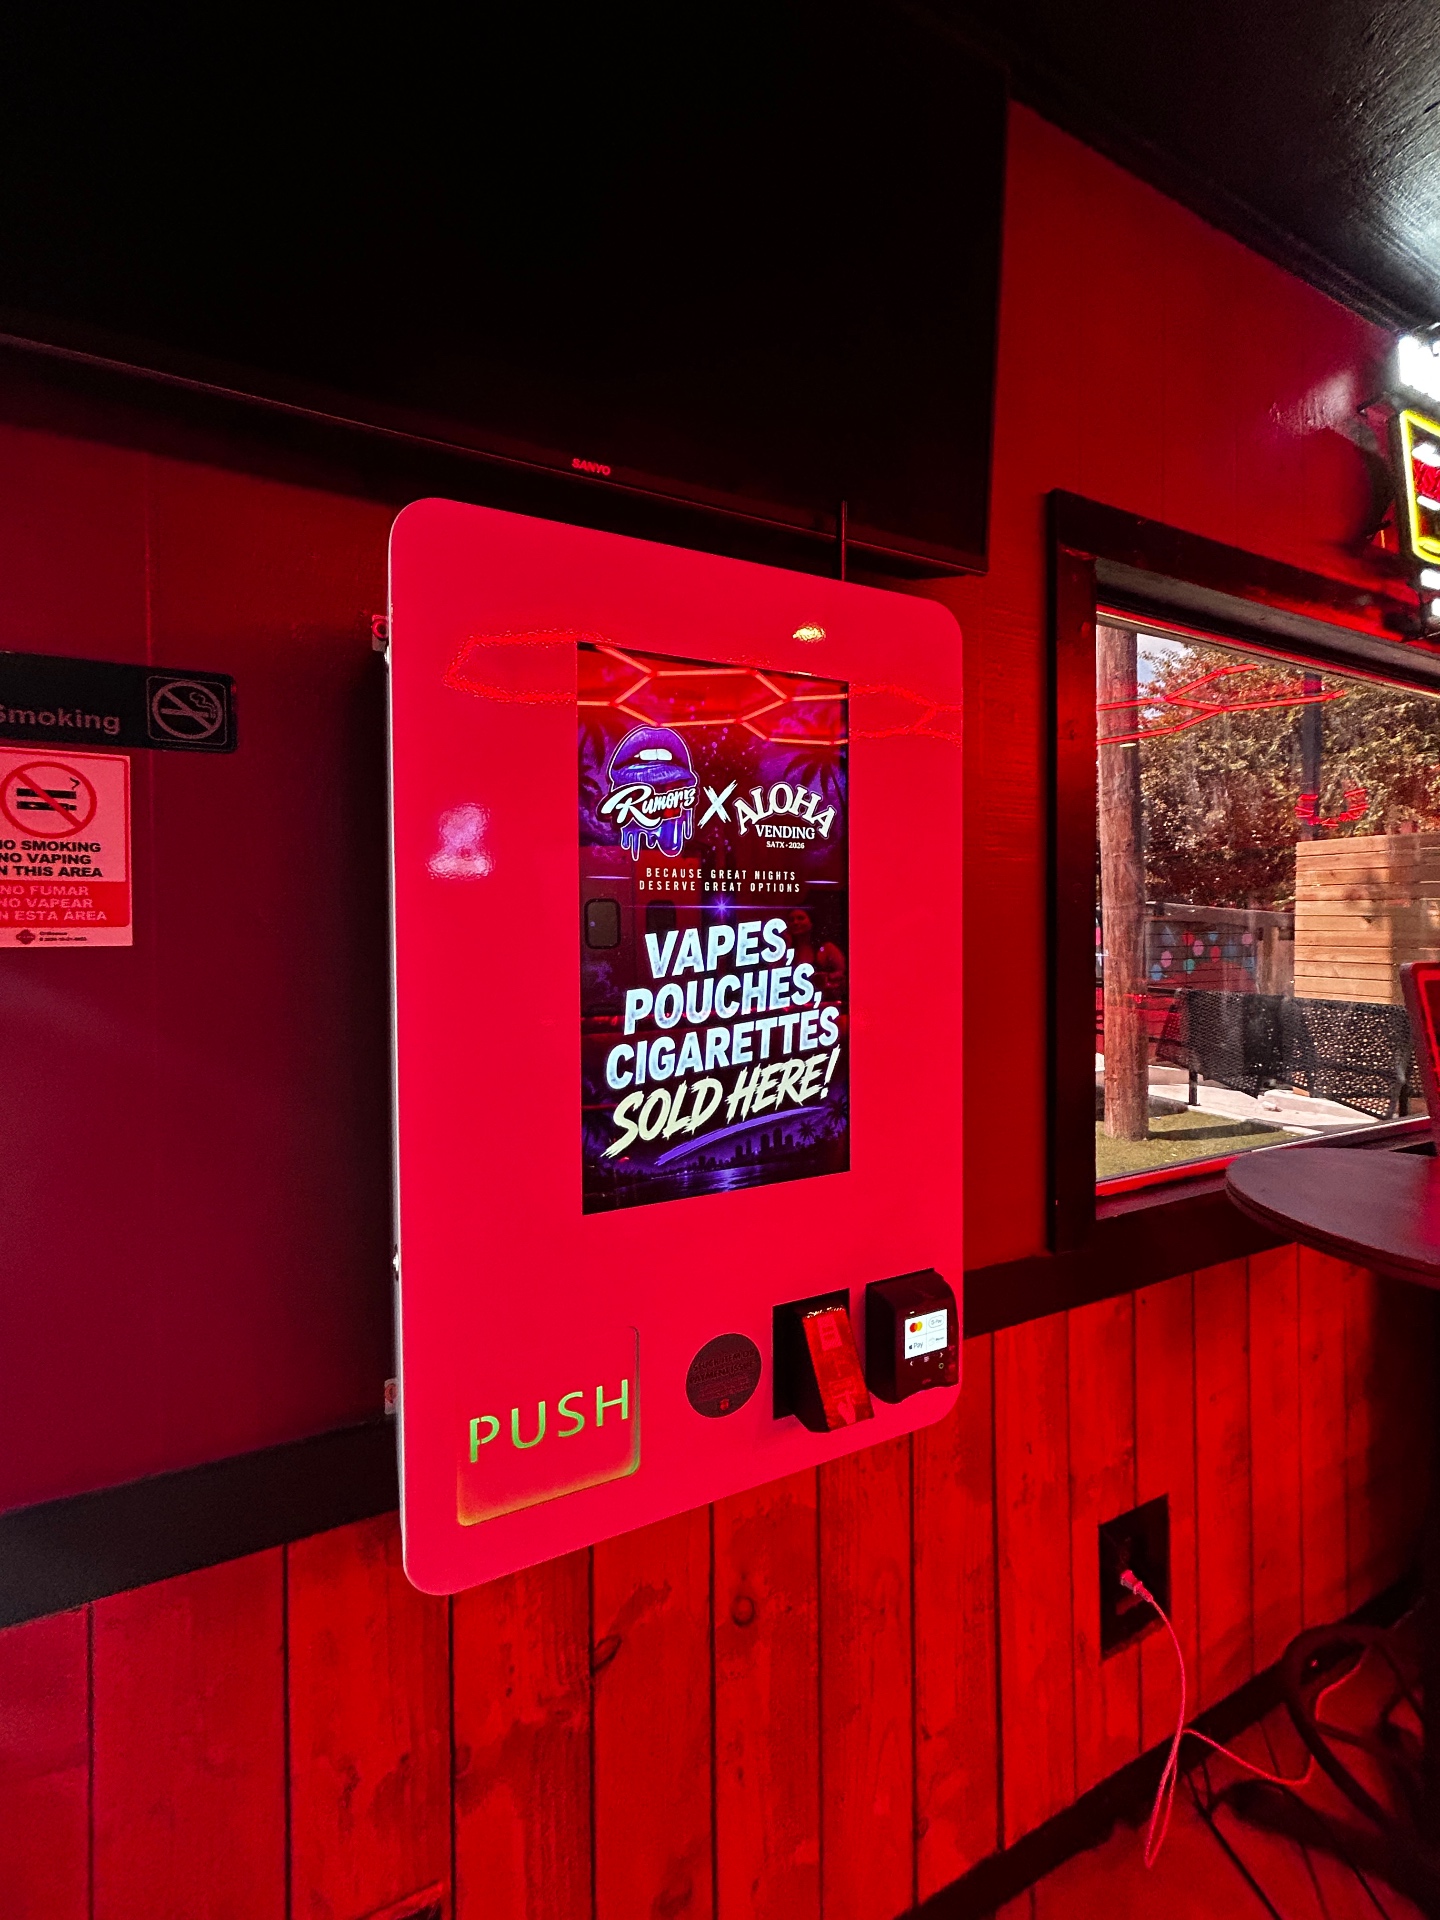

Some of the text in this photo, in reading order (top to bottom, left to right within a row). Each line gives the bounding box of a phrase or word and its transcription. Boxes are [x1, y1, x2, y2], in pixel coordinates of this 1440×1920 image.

[571, 457, 612, 477] SANYO
[733, 783, 836, 838] ALOHA
[755, 825, 816, 840] VENDING
[20, 840, 102, 853] SMOKING
[788, 842, 805, 850] 2026
[26, 853, 92, 865] VAPING
[13, 866, 54, 877] THIS
[58, 867, 103, 878] AREA
[646, 868, 797, 881] BECAUSE GREAT NIGHTS
[0, 885, 89, 896] NO FUMAR
[639, 880, 801, 893] DESERVE GREAT OPTIONS
[26, 898, 94, 909] VAPEAR
[14, 911, 59, 921] ESTA
[645, 918, 795, 979] VAPES,
[623, 962, 823, 1036] POUCHES,
[605, 1006, 840, 1090] CIGARETTES
[600, 1044, 842, 1158] SOLD HERE!
[913, 1341, 924, 1349] Pay
[469, 1379, 628, 1463] PUSH
